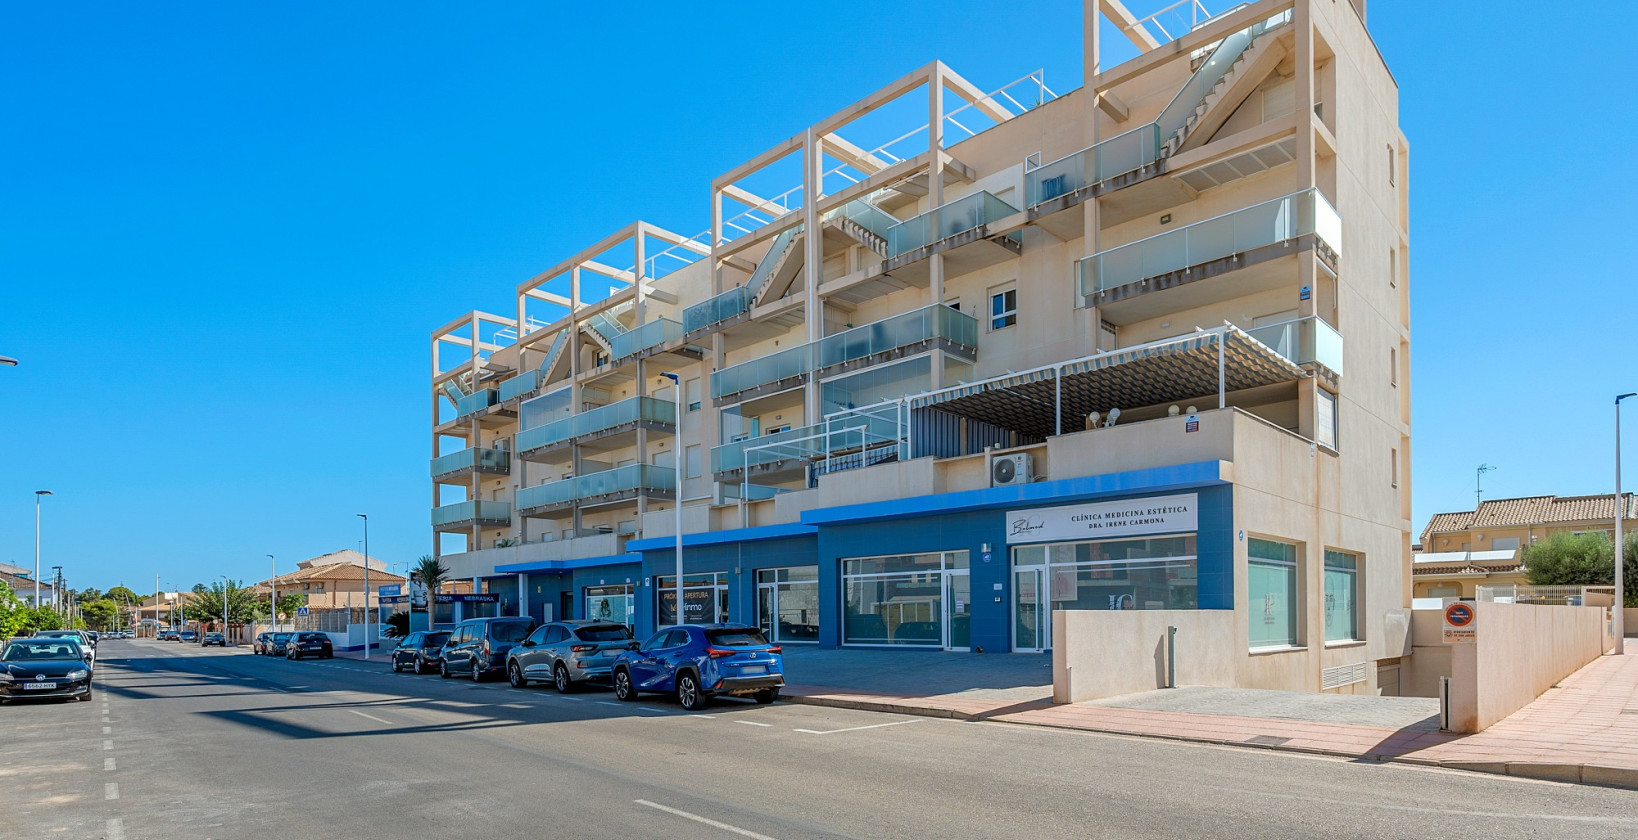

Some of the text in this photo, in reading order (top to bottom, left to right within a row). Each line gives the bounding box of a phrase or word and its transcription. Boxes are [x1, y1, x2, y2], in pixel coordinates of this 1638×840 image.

[1071, 505, 1188, 522] CLÍNICA MEDICINA ESTÉTICA
[1105, 520, 1127, 528] IRENE
[1129, 517, 1165, 526] CARMONA
